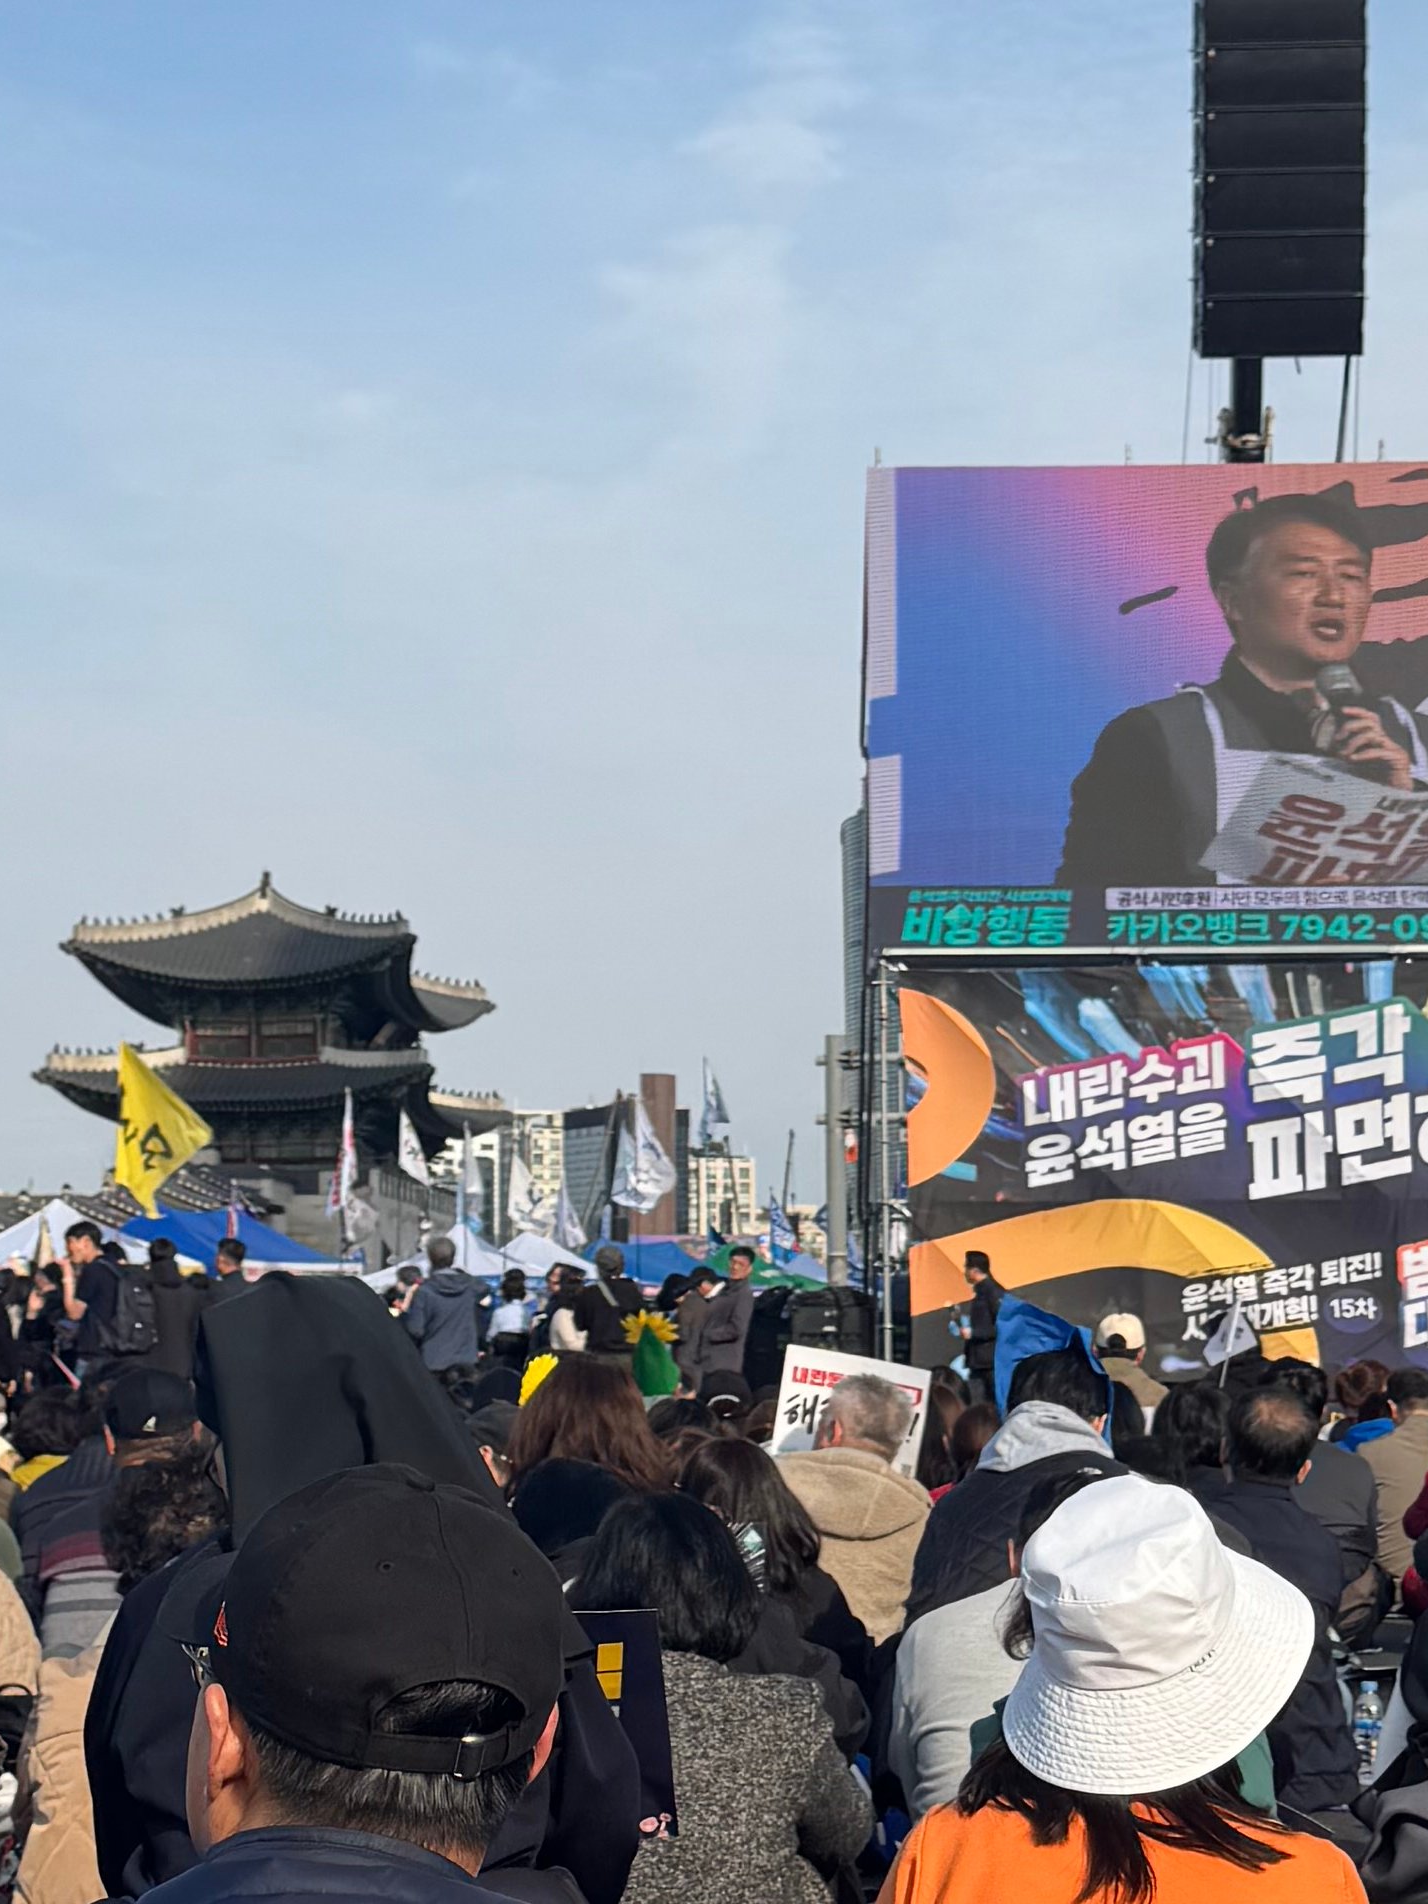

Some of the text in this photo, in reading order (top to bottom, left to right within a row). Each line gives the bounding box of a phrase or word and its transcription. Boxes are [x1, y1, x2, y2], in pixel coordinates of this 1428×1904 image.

[901, 904, 1071, 946] 비상행동
[1106, 911, 1272, 945] 카카오뱅크
[1248, 1003, 1412, 1104] 즉각
[1023, 1040, 1226, 1127] 내란수괴
[1025, 1102, 1228, 1189] 윤석열을
[1181, 1251, 1383, 1314] 윤석열 즉각 퇴진!
[1329, 1297, 1378, 1320] 15차
[791, 1365, 845, 1389] 내란동
